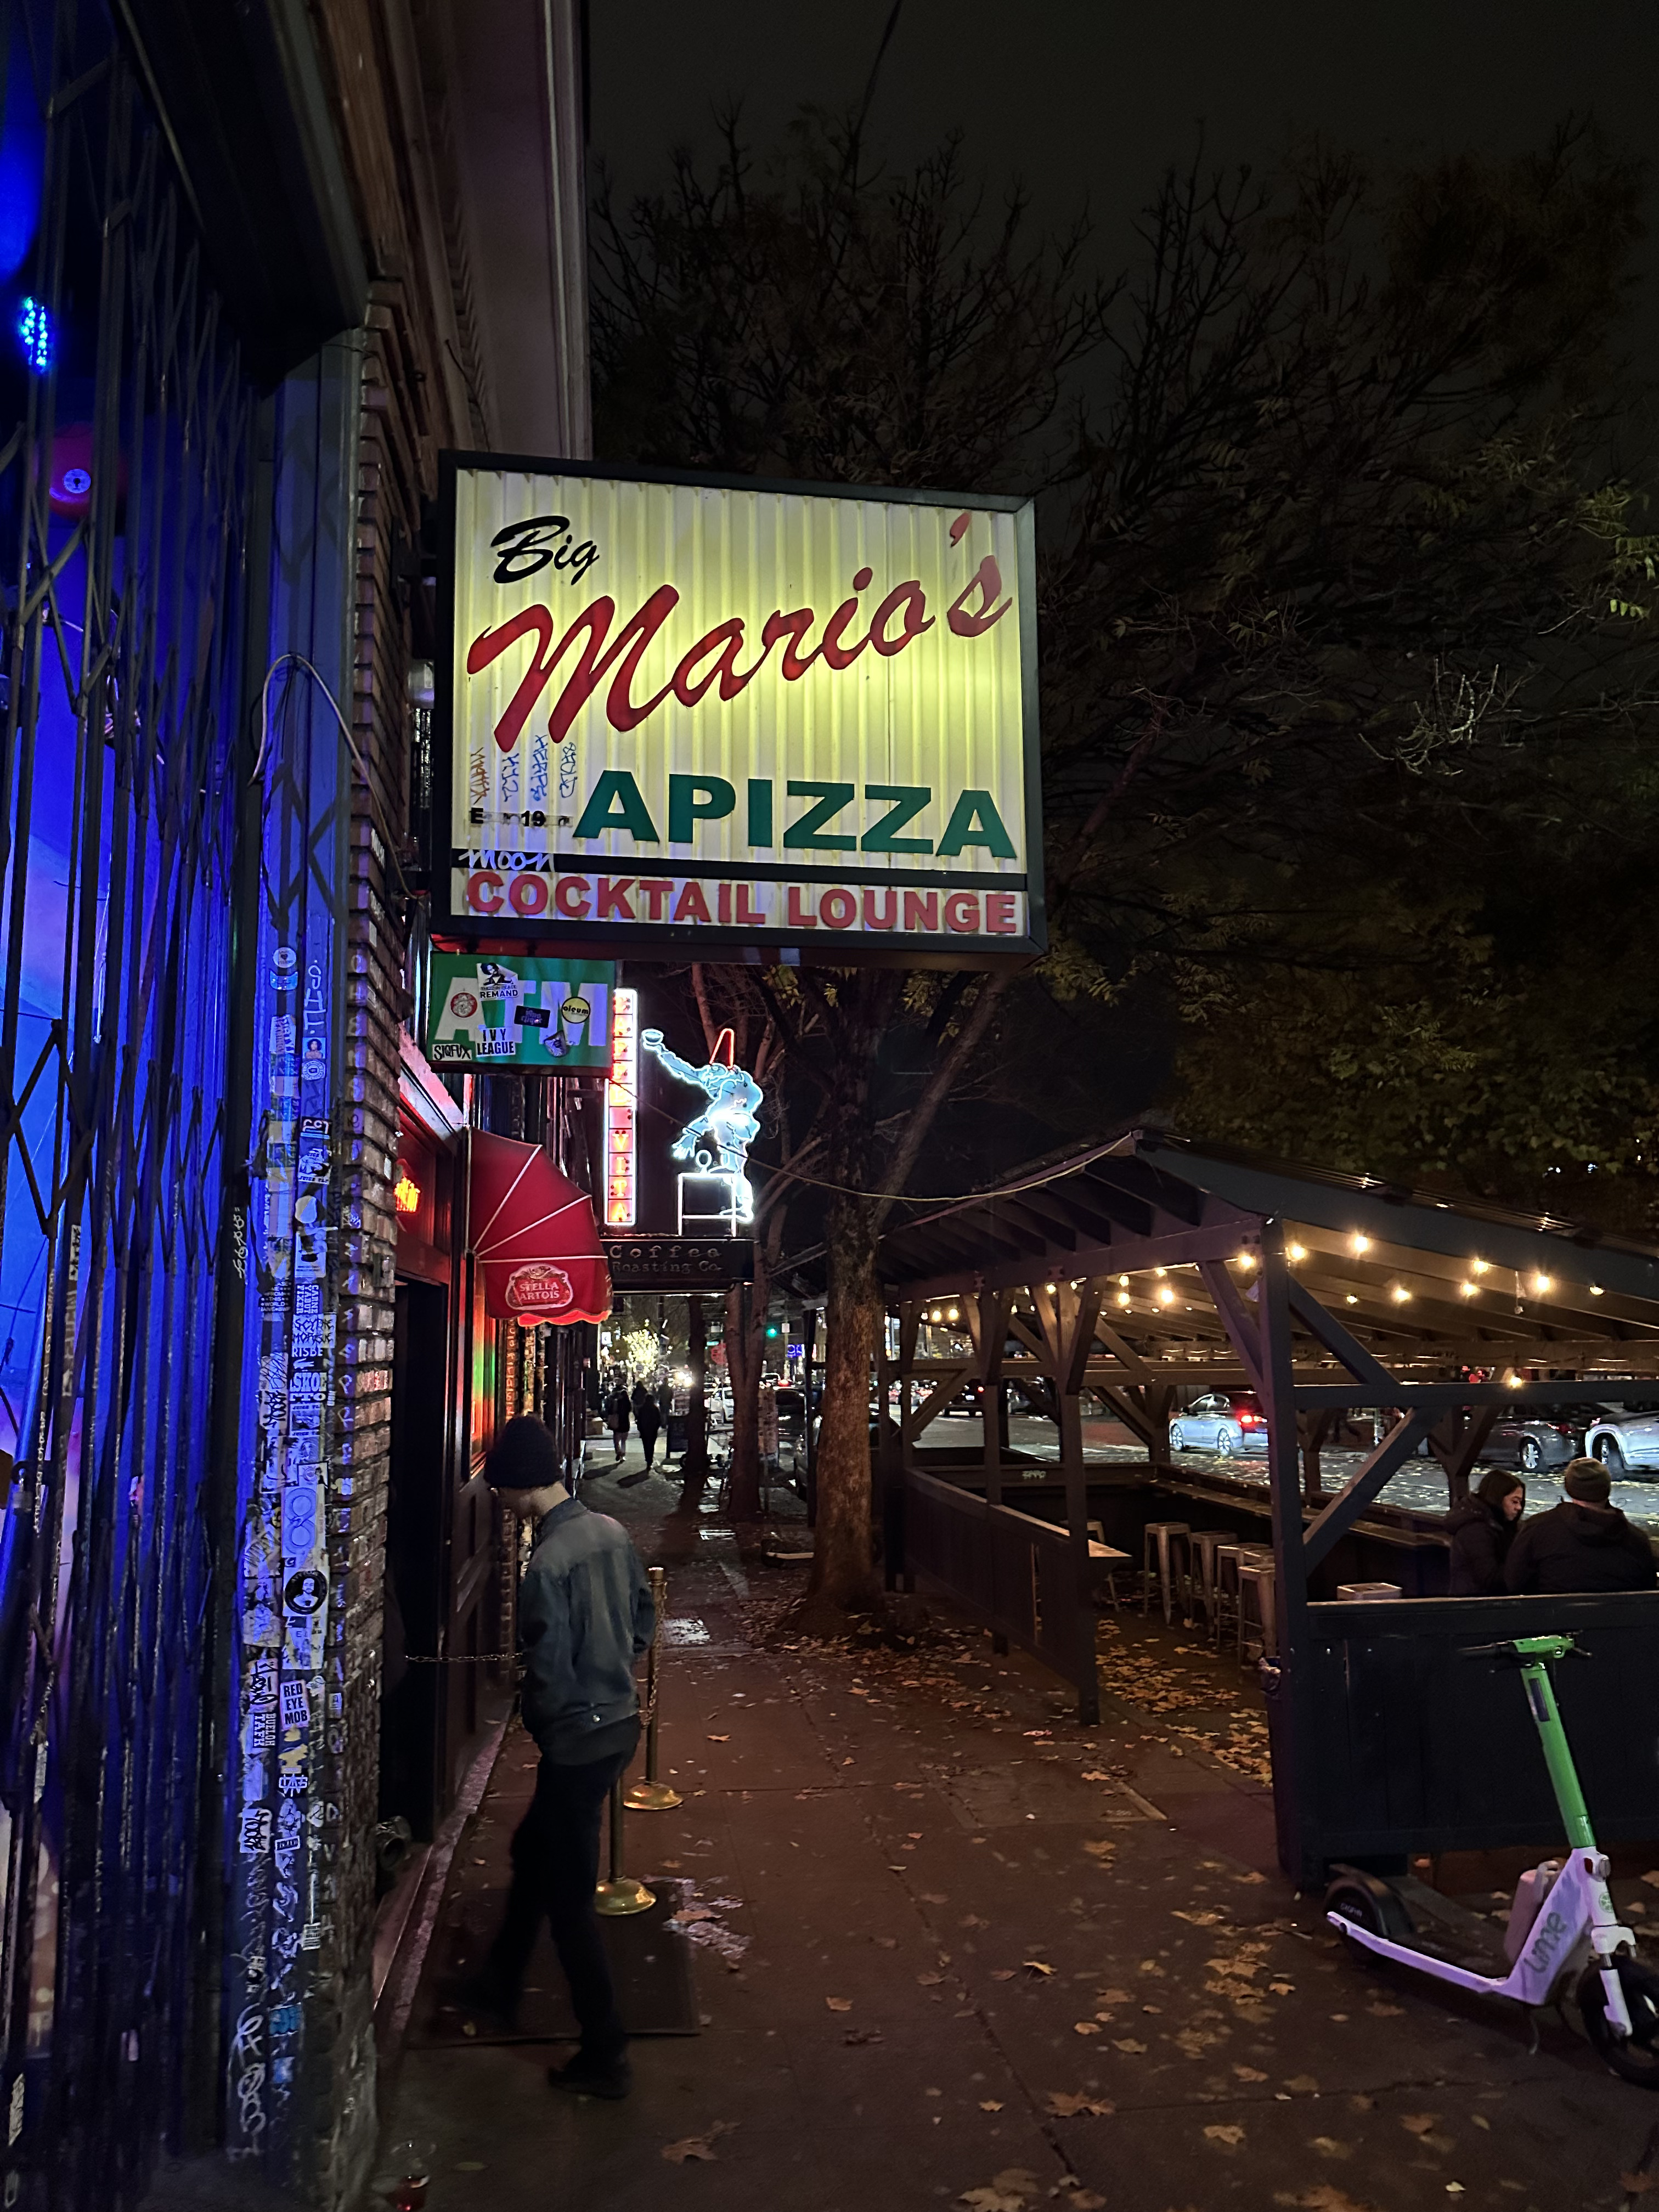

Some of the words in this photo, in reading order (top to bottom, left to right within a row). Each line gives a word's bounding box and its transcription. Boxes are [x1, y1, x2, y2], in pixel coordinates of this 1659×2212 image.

[491, 515, 600, 585] Big
[467, 512, 1013, 753] Mario's
[573, 770, 1017, 858] APIZZA
[467, 870, 765, 924] COCKTAIL
[788, 886, 1016, 933] LOUNGE
[479, 989, 518, 998] REMAND
[435, 977, 608, 1047] ATM
[477, 1041, 515, 1055] LEAGUE
[611, 1133, 629, 1221] VITA
[610, 1245, 721, 1259] Coffee
[612, 1261, 692, 1274] Roasting
[519, 1282, 560, 1292] STELLA
[520, 1290, 560, 1300] ARTOIS
[284, 1683, 303, 1697] RED
[286, 1697, 304, 1711] EYE
[284, 1709, 308, 1725] MOB
